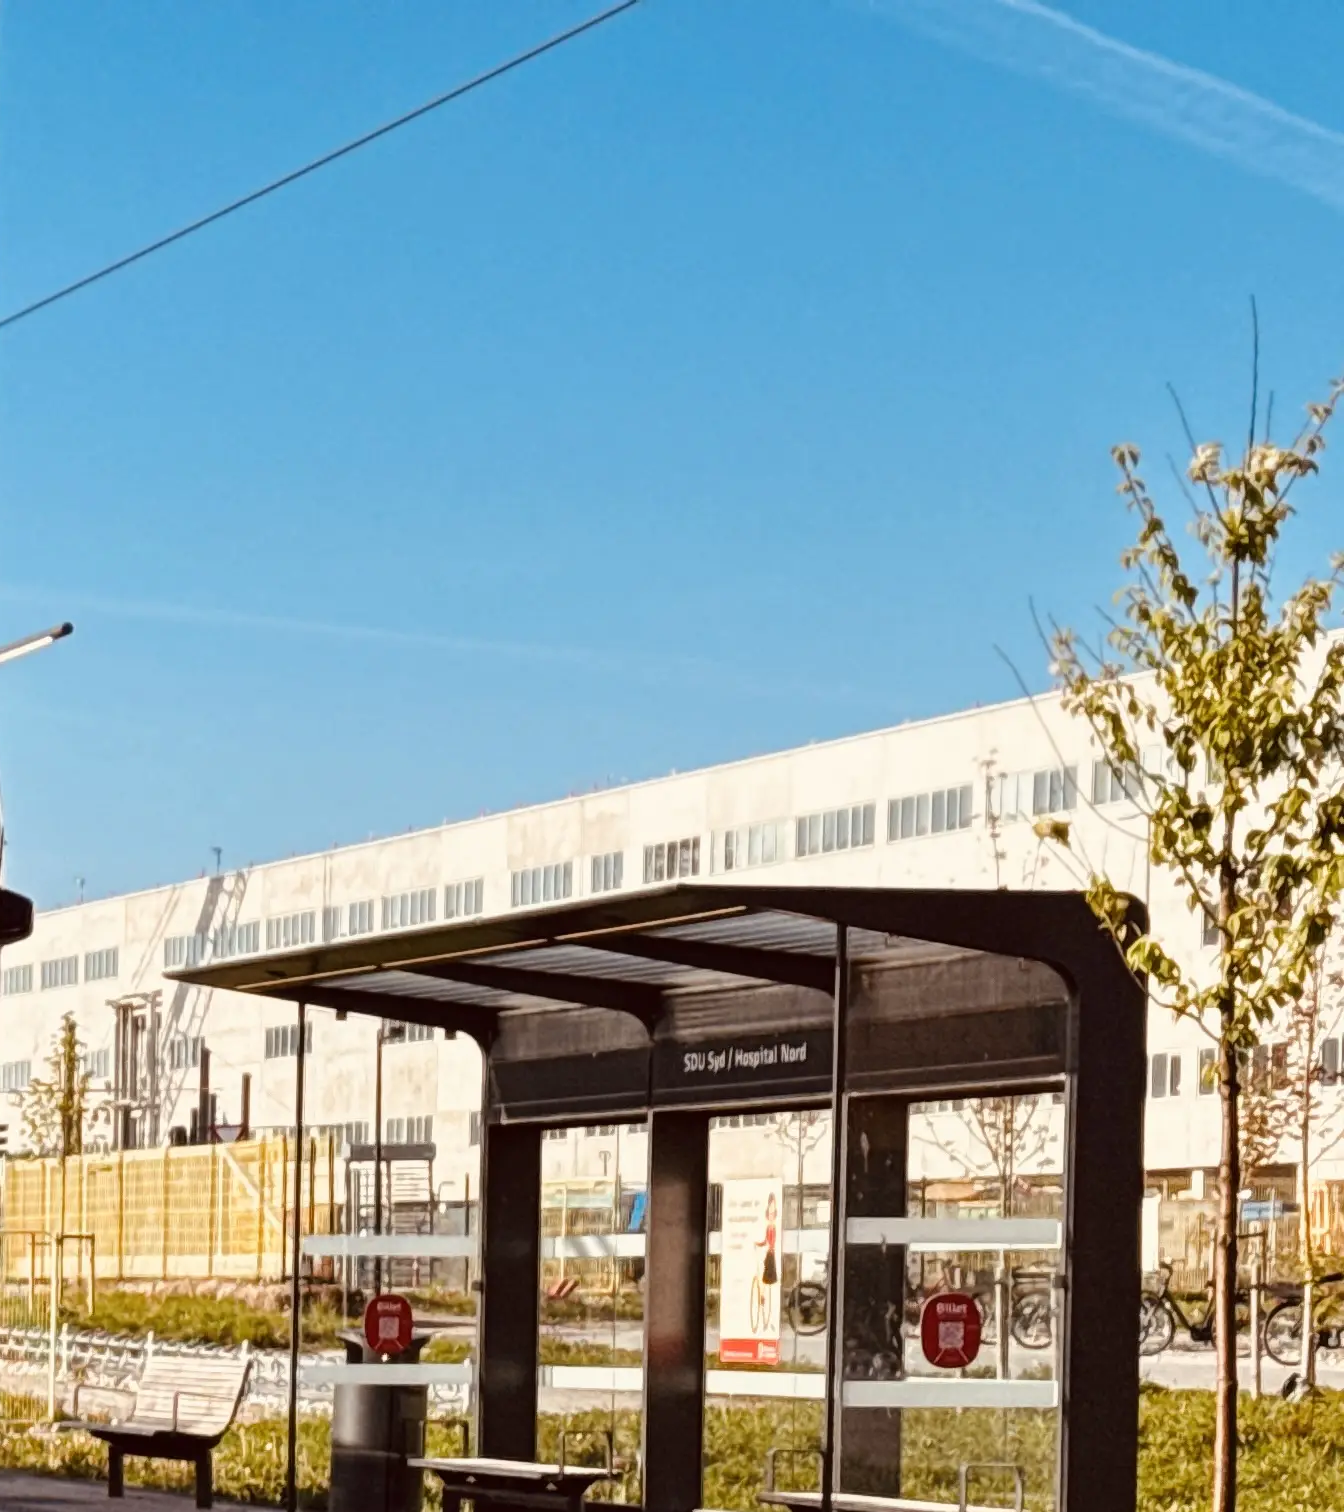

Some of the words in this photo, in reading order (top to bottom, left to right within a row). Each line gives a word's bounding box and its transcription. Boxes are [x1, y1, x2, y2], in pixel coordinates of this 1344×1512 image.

[683, 1052, 705, 1073] SDU
[707, 1050, 726, 1075] Syd
[734, 1044, 778, 1071] Hospital
[780, 1041, 808, 1063] Nord
